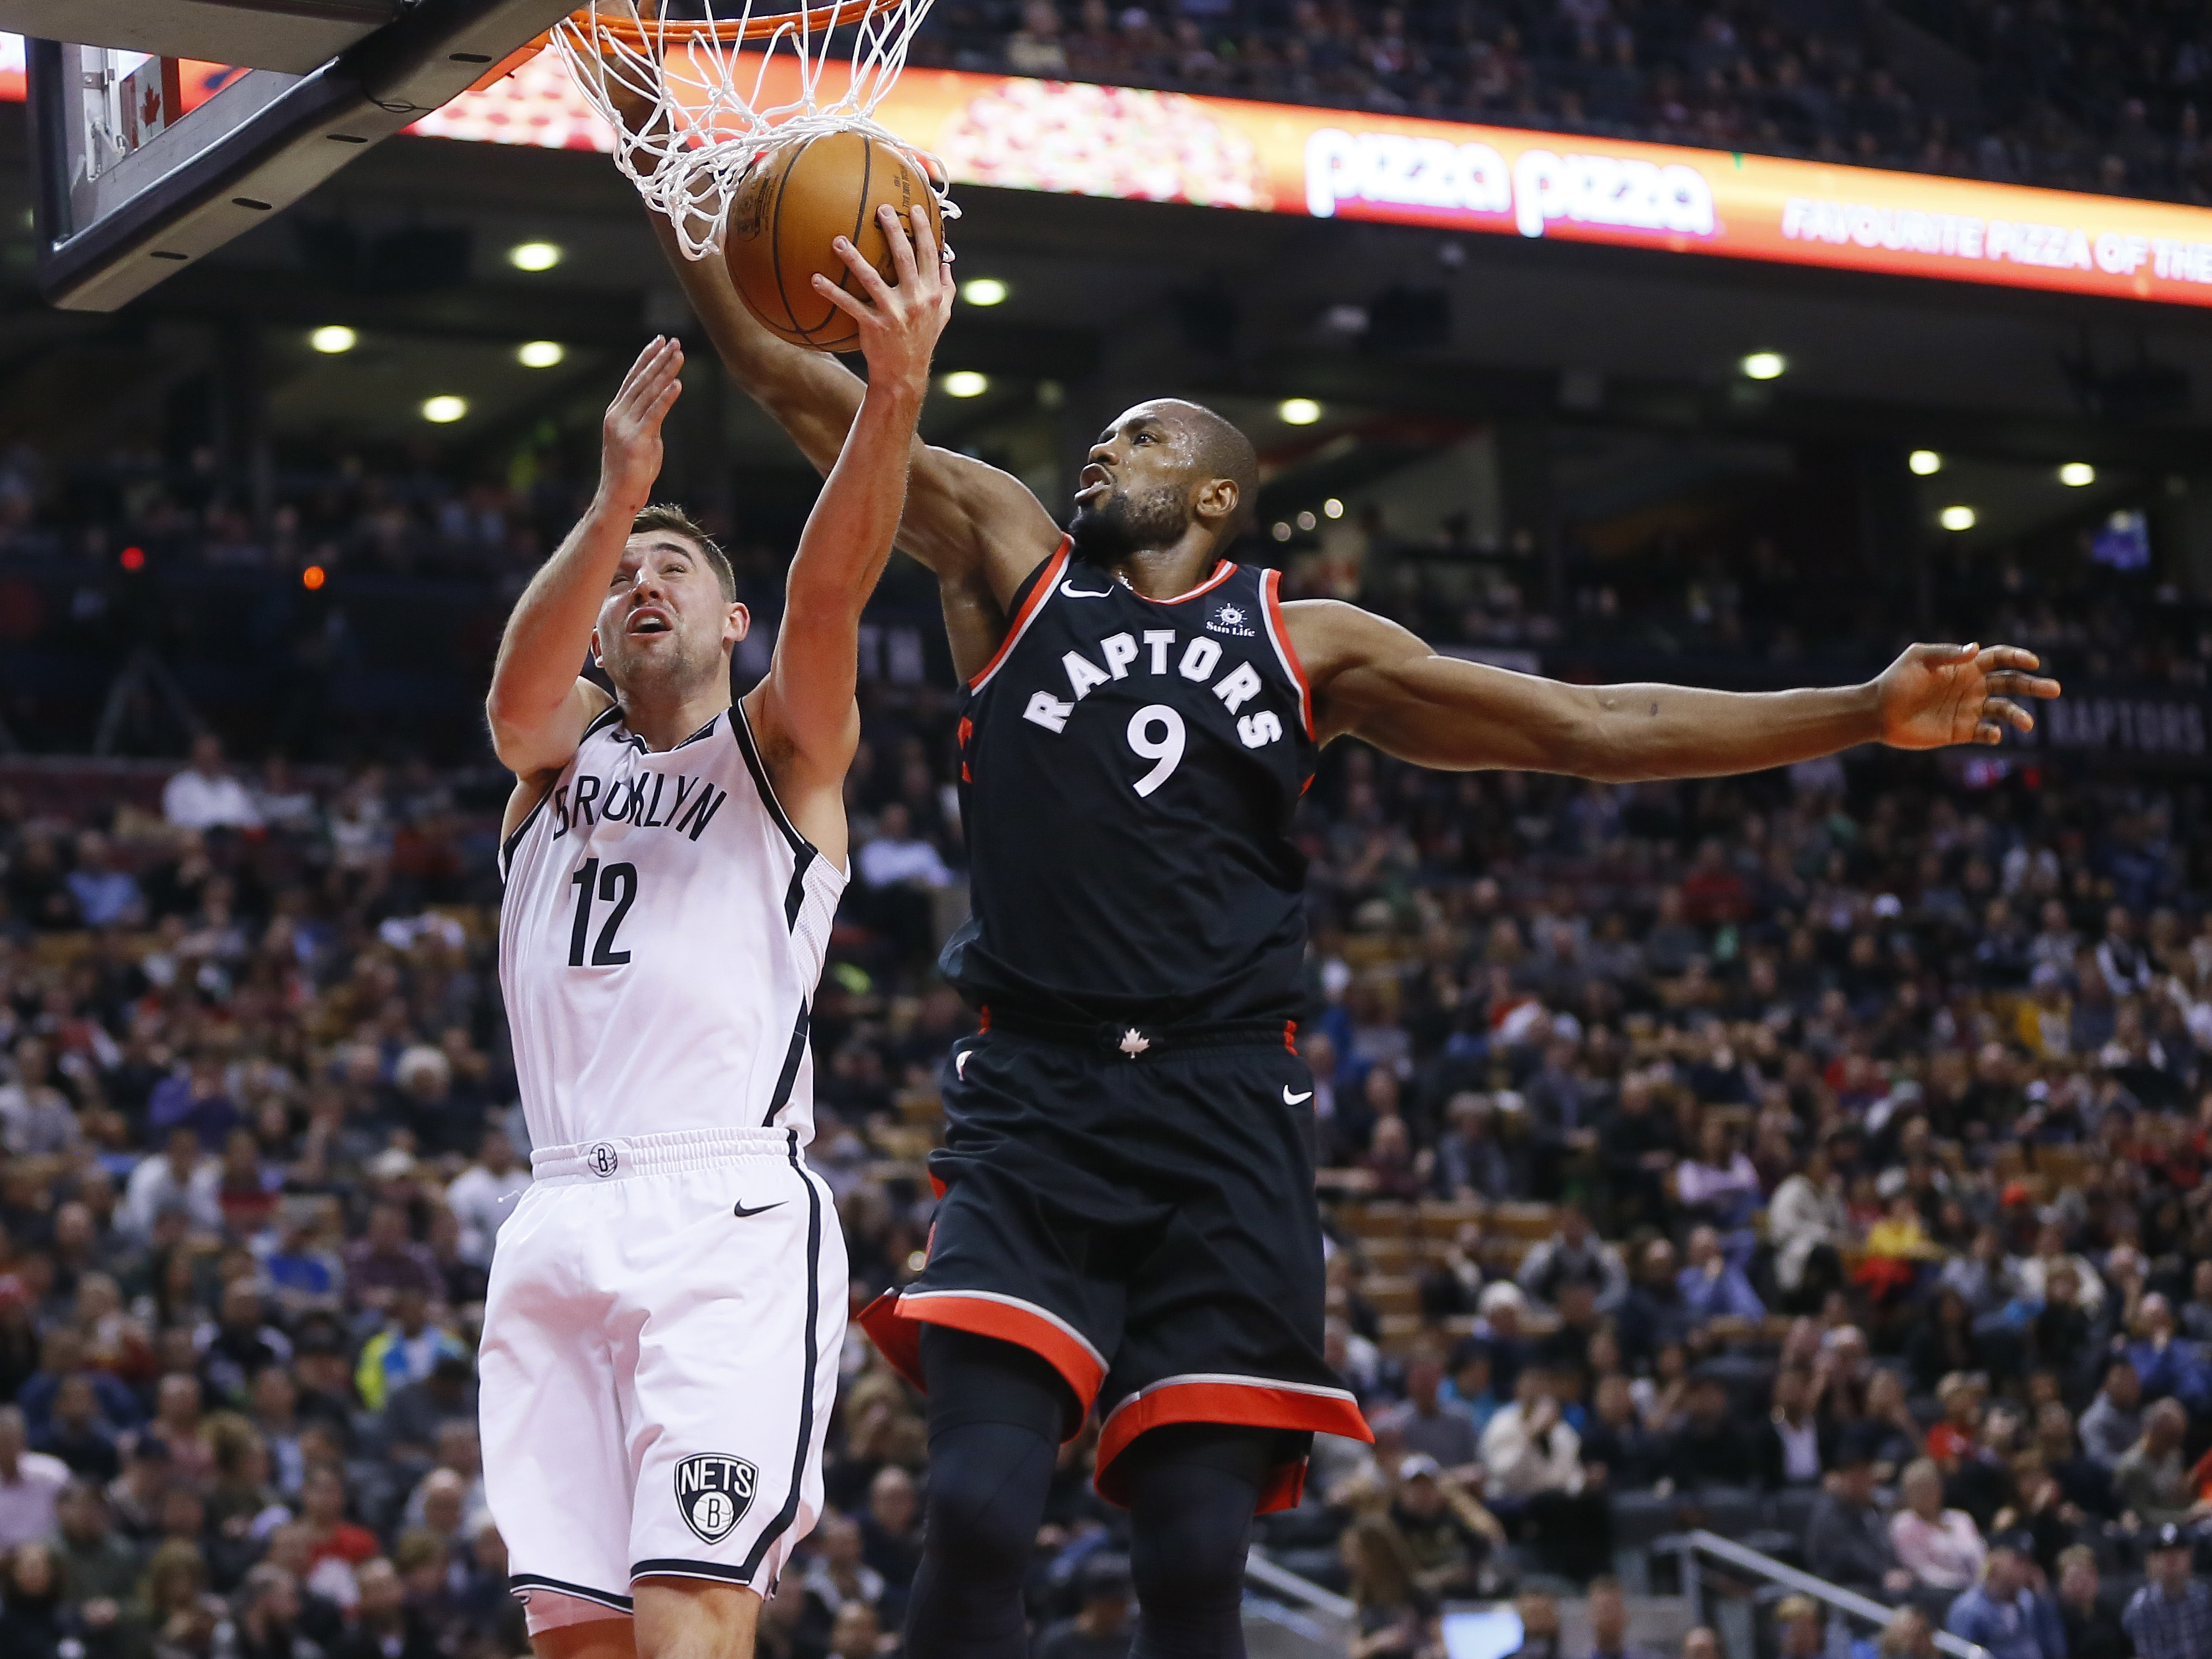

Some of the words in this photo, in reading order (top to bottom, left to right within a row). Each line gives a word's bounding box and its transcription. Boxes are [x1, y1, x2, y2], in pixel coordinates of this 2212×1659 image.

[1305, 128, 1511, 217] pizza
[1514, 149, 1713, 238] pizza
[1781, 197, 1984, 259] FAVOURITE
[1987, 219, 2093, 272] PIZZA
[2095, 233, 2147, 275] OF
[1206, 621, 1231, 634] Sun
[1232, 626, 1255, 637] Life
[1022, 630, 1283, 749] RAPTORS
[1127, 704, 1186, 798] 9
[568, 857, 638, 967] 12
[598, 1148, 608, 1172] B
[681, 1458, 752, 1498] NETS
[707, 1498, 720, 1528] B
